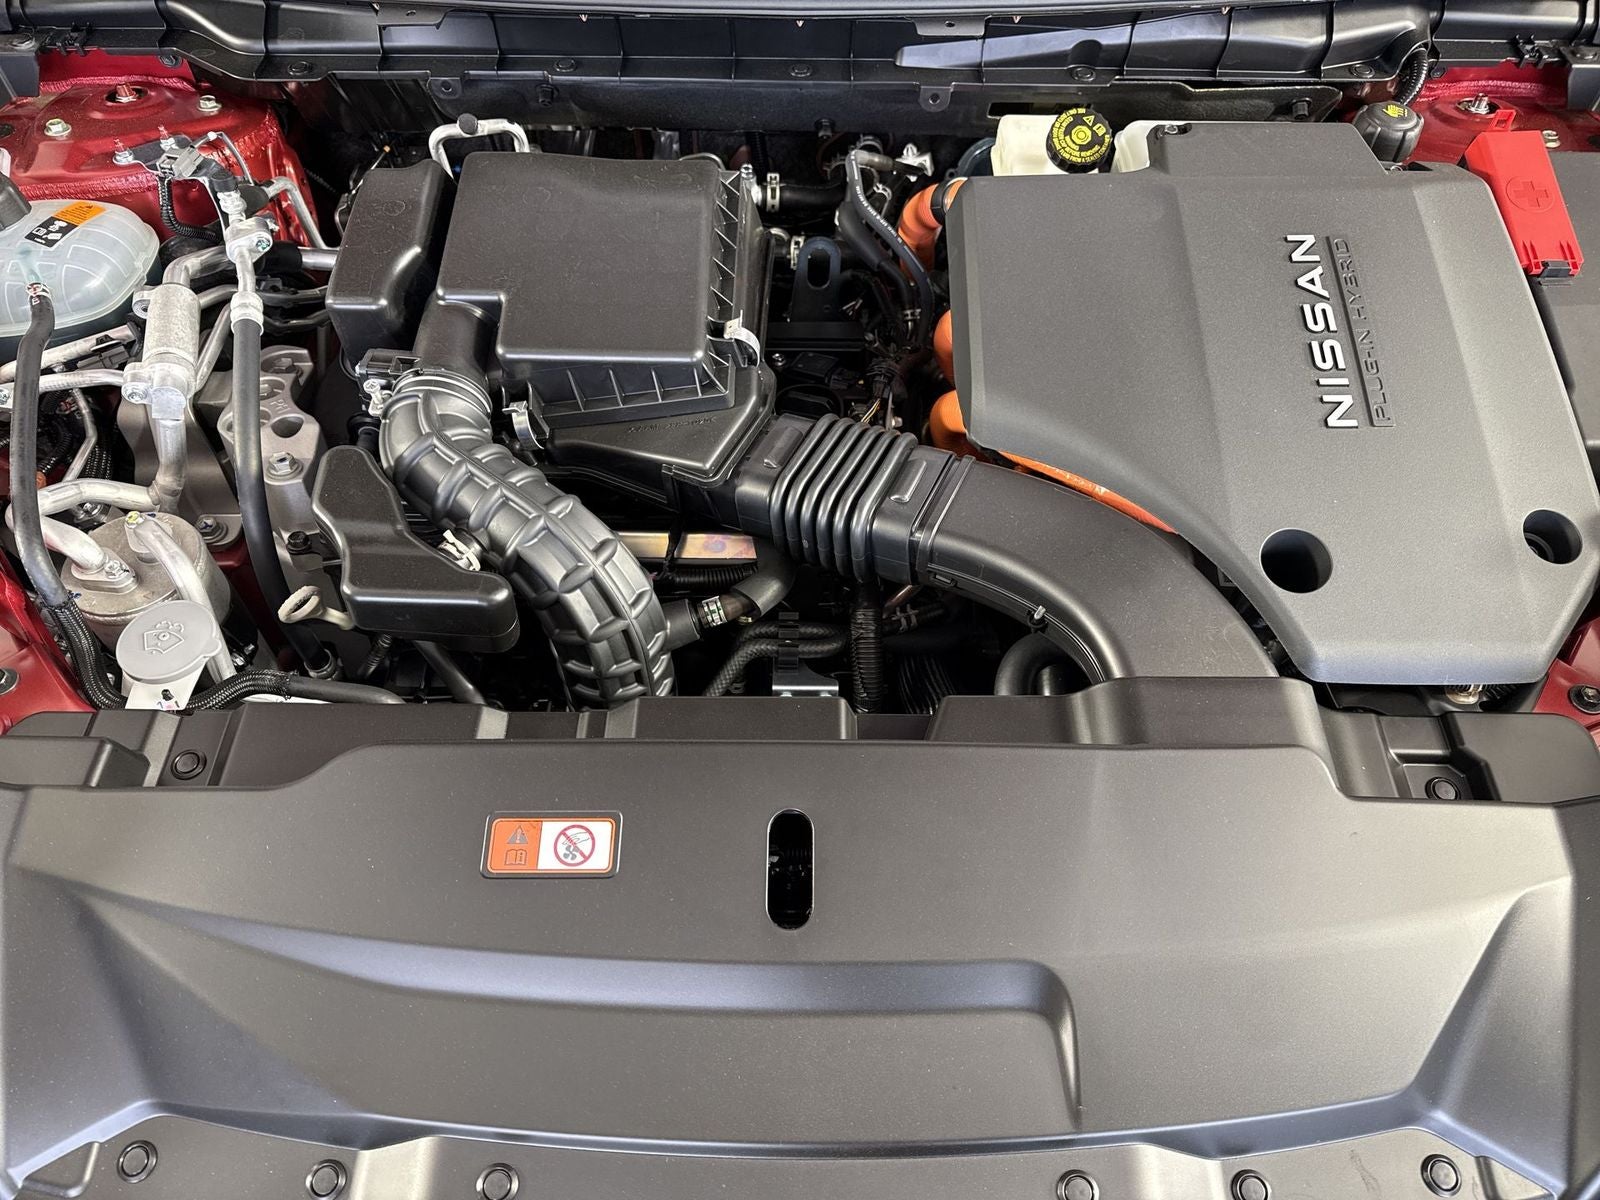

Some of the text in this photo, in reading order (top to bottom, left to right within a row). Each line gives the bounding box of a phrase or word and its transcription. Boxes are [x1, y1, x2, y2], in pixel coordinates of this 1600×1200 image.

[1284, 234, 1359, 428] NISSAN
[1333, 238, 1392, 421] PLUG-IN HYBRID
